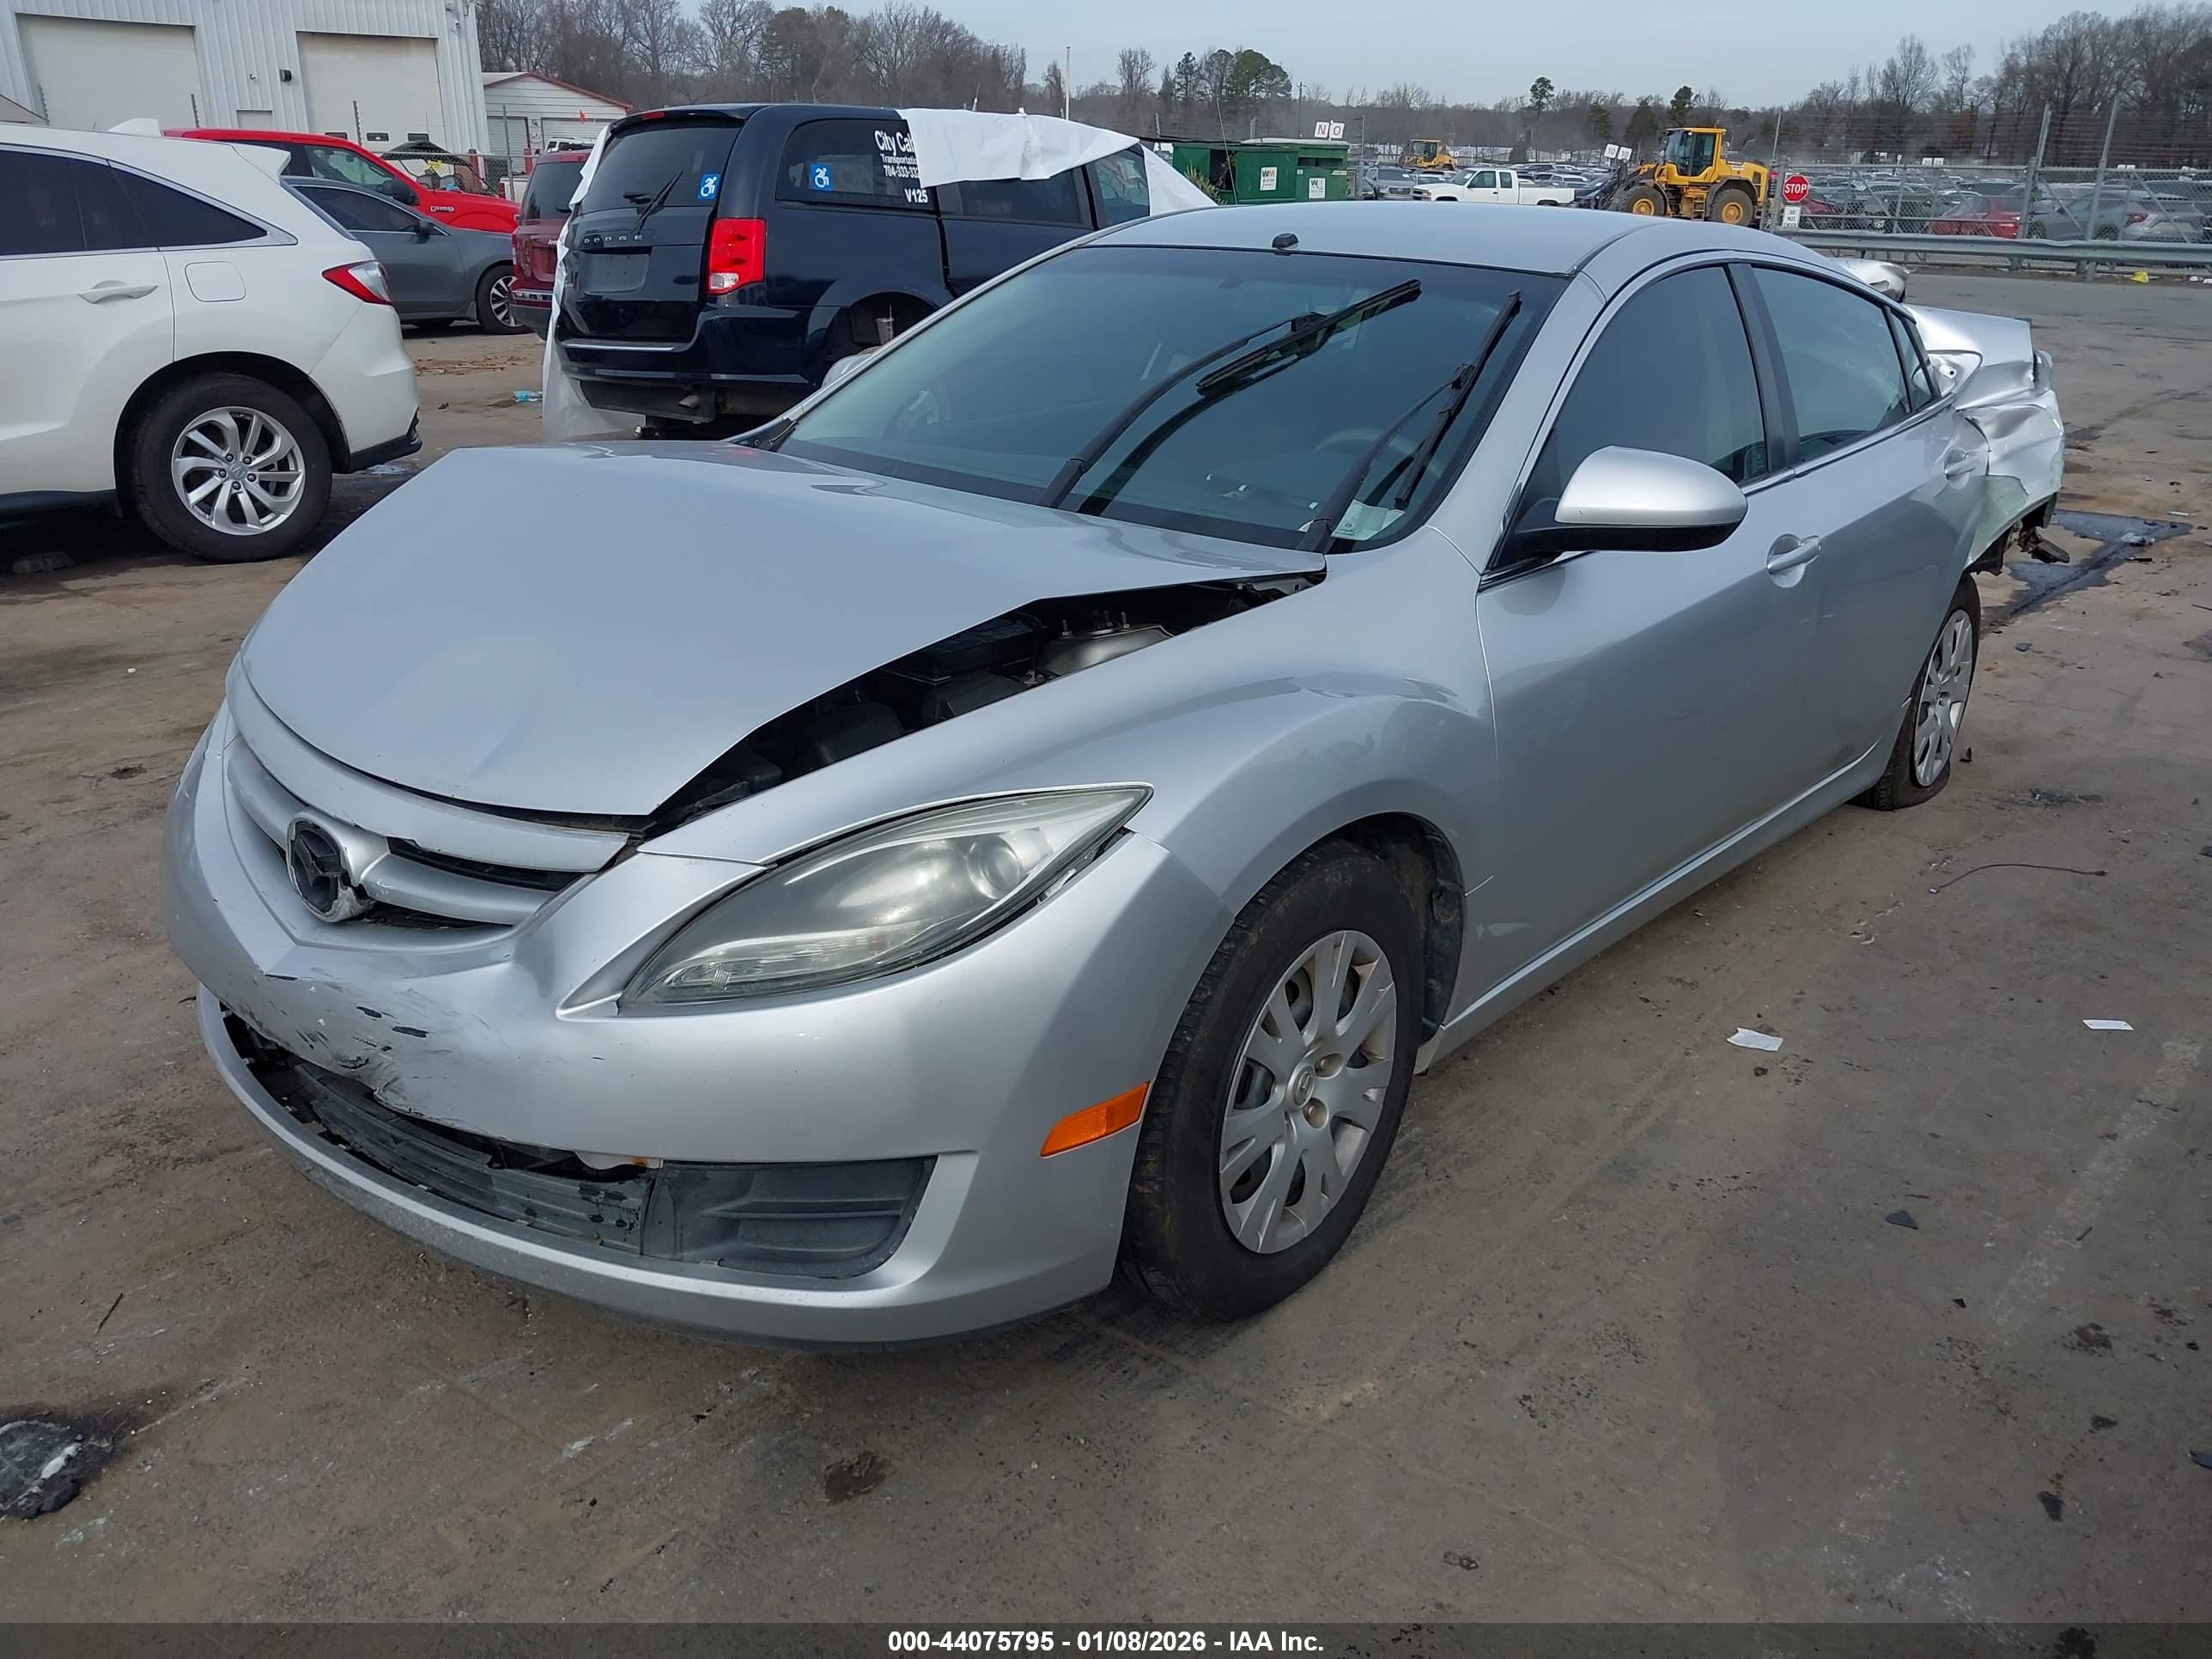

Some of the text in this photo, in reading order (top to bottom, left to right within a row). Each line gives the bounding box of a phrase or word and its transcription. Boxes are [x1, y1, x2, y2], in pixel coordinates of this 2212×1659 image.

[874, 130, 896, 156] City
[1785, 183, 1807, 194] STOP
[904, 188, 928, 204] V125
[584, 234, 643, 244] DODGE
